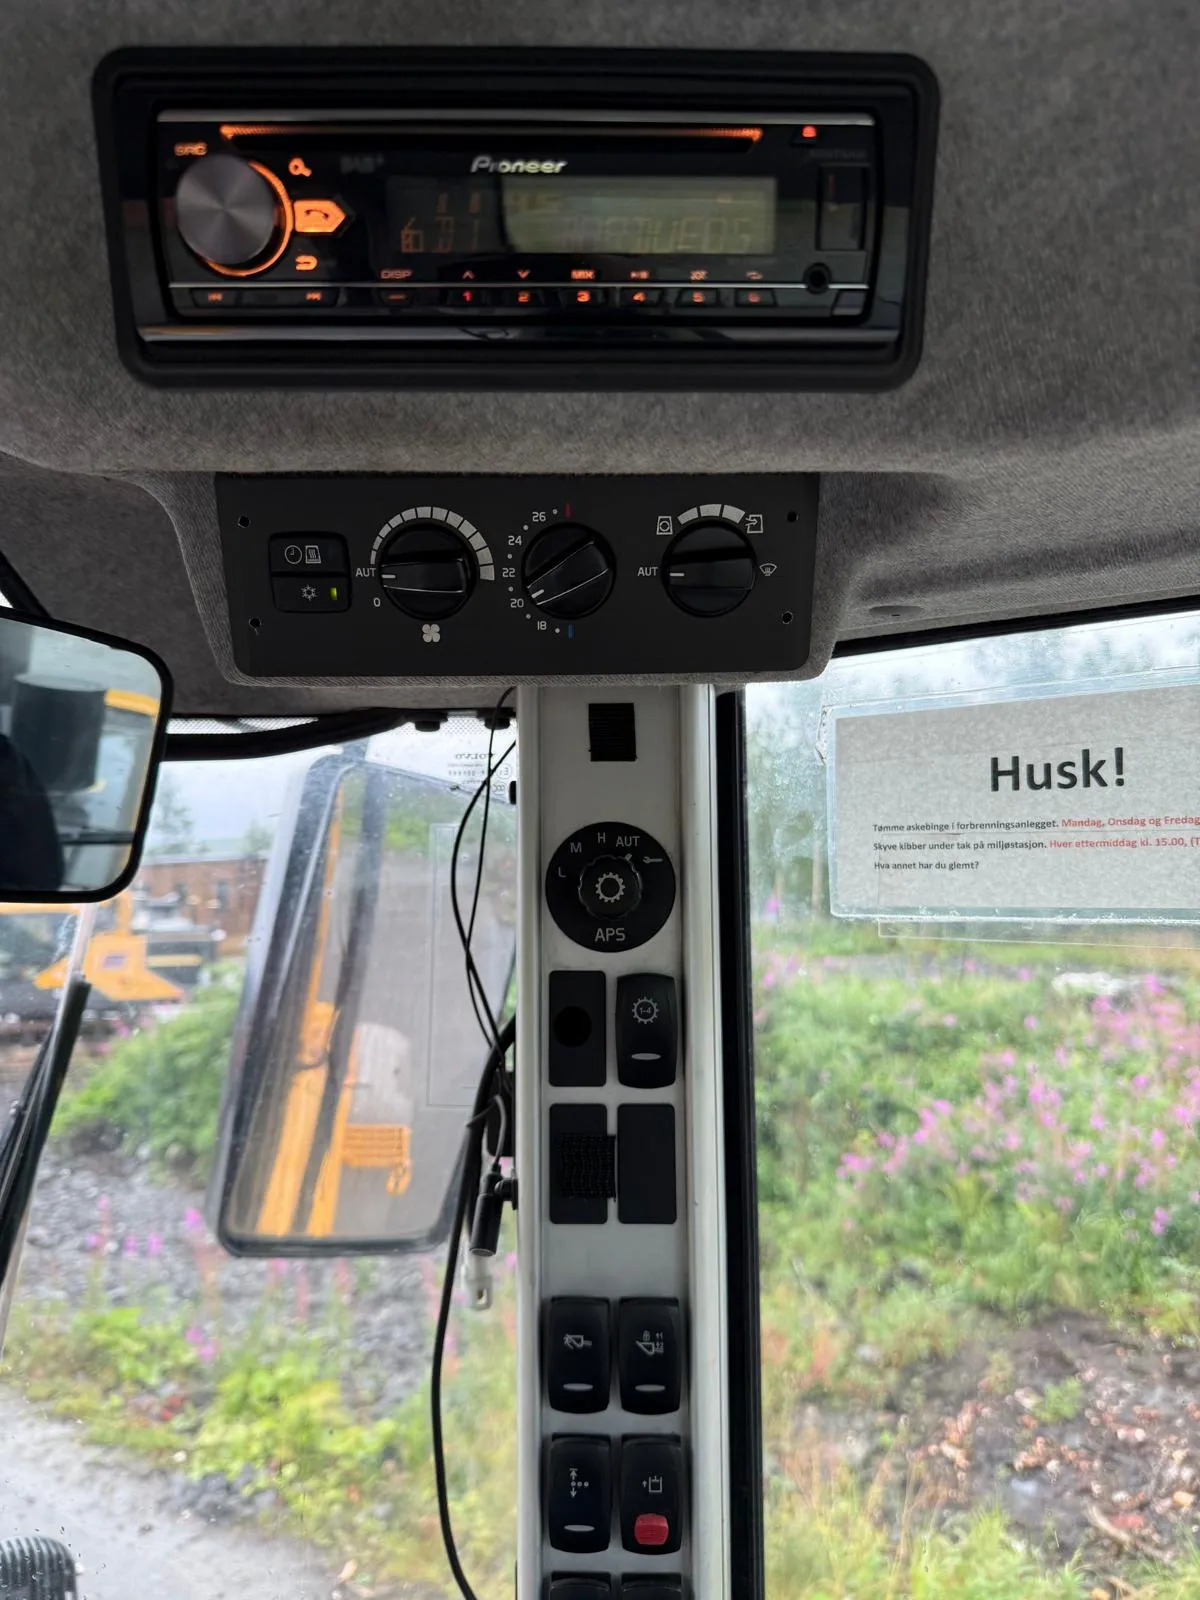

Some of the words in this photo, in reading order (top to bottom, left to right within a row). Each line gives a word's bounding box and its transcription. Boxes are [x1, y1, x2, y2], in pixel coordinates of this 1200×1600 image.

[471, 154, 568, 175] Pioneer
[463, 291, 472, 302] 1
[518, 291, 529, 302] 2
[577, 291, 591, 302] 3
[633, 292, 645, 302] 4
[532, 511, 547, 522] 26
[507, 535, 523, 546] 24
[355, 567, 377, 578] AUT
[501, 567, 516, 578] 22
[637, 566, 659, 577] AUT
[510, 598, 525, 609] 20
[536, 621, 548, 631] 18
[990, 747, 1126, 793] Husk!
[873, 824, 905, 833] Tømme
[906, 823, 950, 833] askebinge
[956, 819, 1059, 832] forbrenningsanlegget.
[1061, 818, 1105, 829] Mandag,
[1107, 817, 1146, 827] Onsdag
[1149, 818, 1161, 827] og
[597, 832, 606, 844] H
[615, 835, 641, 847] AUT
[570, 842, 582, 853] M
[873, 842, 897, 852] Skyve
[899, 841, 926, 851] kibber
[928, 841, 955, 850] under
[956, 841, 971, 850] tak
[973, 840, 985, 851] på
[987, 839, 1047, 851] miljøstasjon.
[1050, 839, 1074, 849] Hver
[1075, 838, 1138, 849] ettermiddag
[1140, 837, 1152, 847] kl.
[1155, 836, 1188, 848] 15.00,
[874, 862, 890, 870] Hva
[892, 861, 917, 870] annet
[918, 861, 932, 870] har
[935, 861, 947, 870] du
[949, 861, 980, 871] glemt?
[558, 866, 567, 878] L
[594, 927, 626, 942] APS
